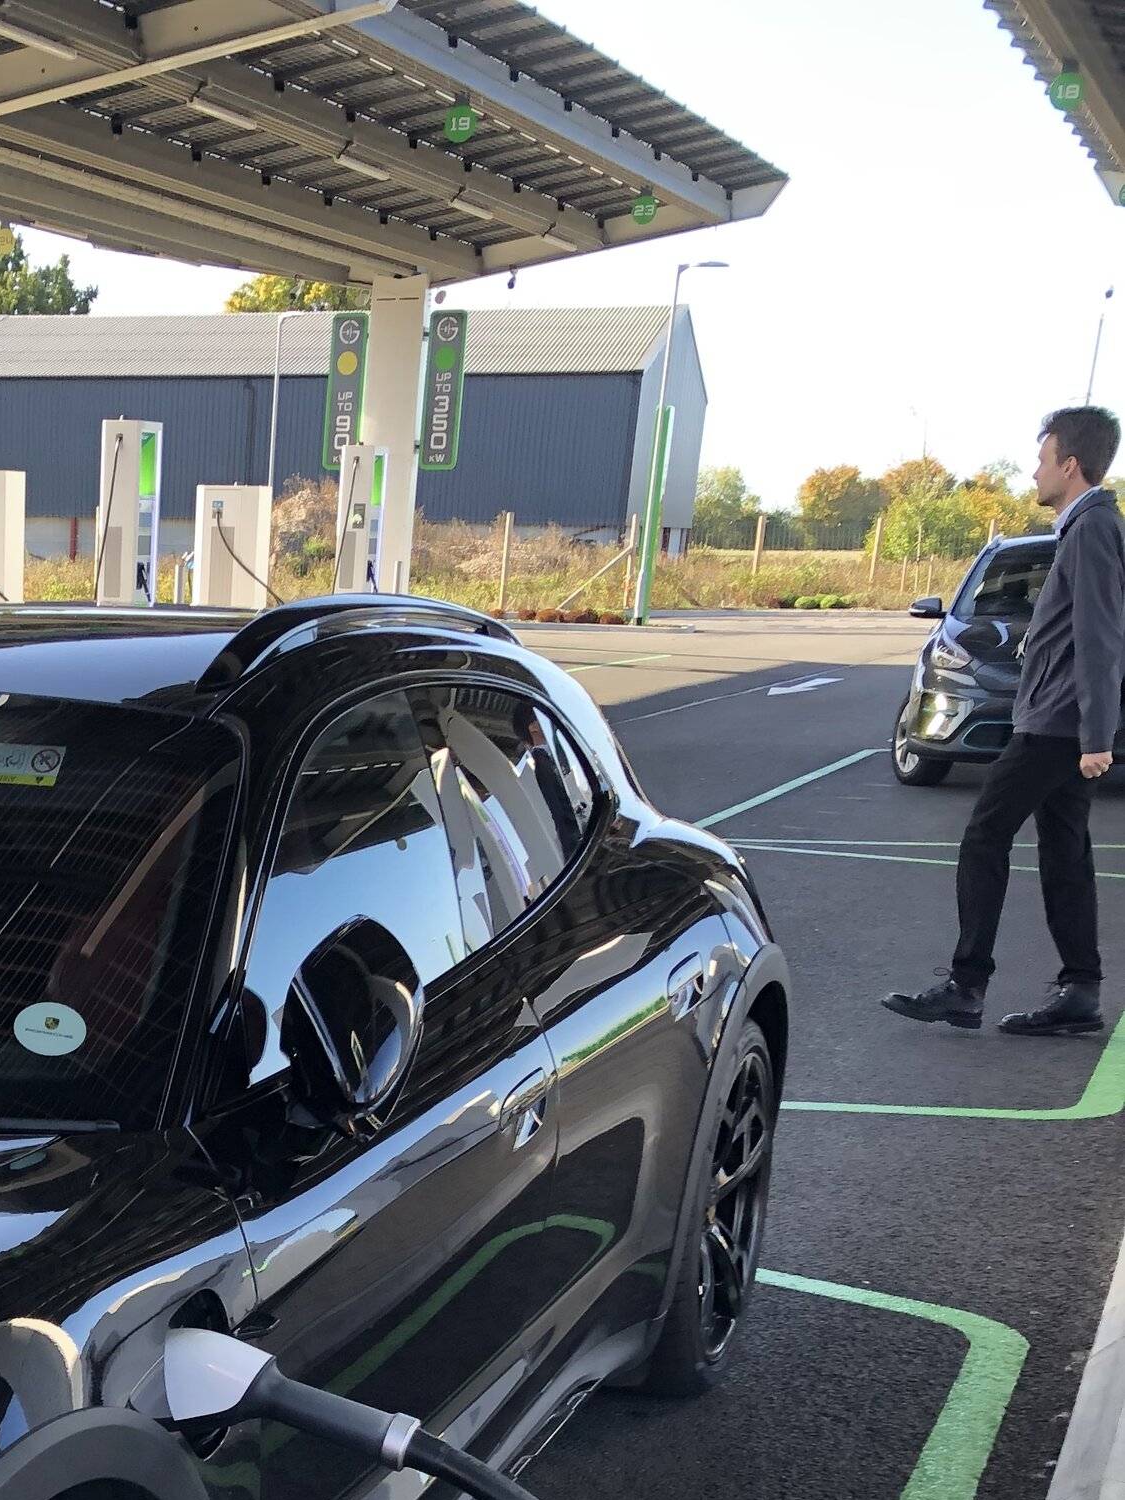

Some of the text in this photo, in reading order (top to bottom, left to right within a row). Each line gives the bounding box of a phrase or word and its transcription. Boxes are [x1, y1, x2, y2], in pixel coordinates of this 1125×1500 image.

[1056, 84, 1081, 99] 18
[450, 116, 471, 131] 19
[633, 204, 654, 216] 23
[436, 372, 452, 381] UP
[435, 383, 451, 393] TO
[337, 391, 353, 401] UP
[337, 402, 353, 411] TO
[430, 395, 450, 450] 350
[334, 415, 351, 450] 90
